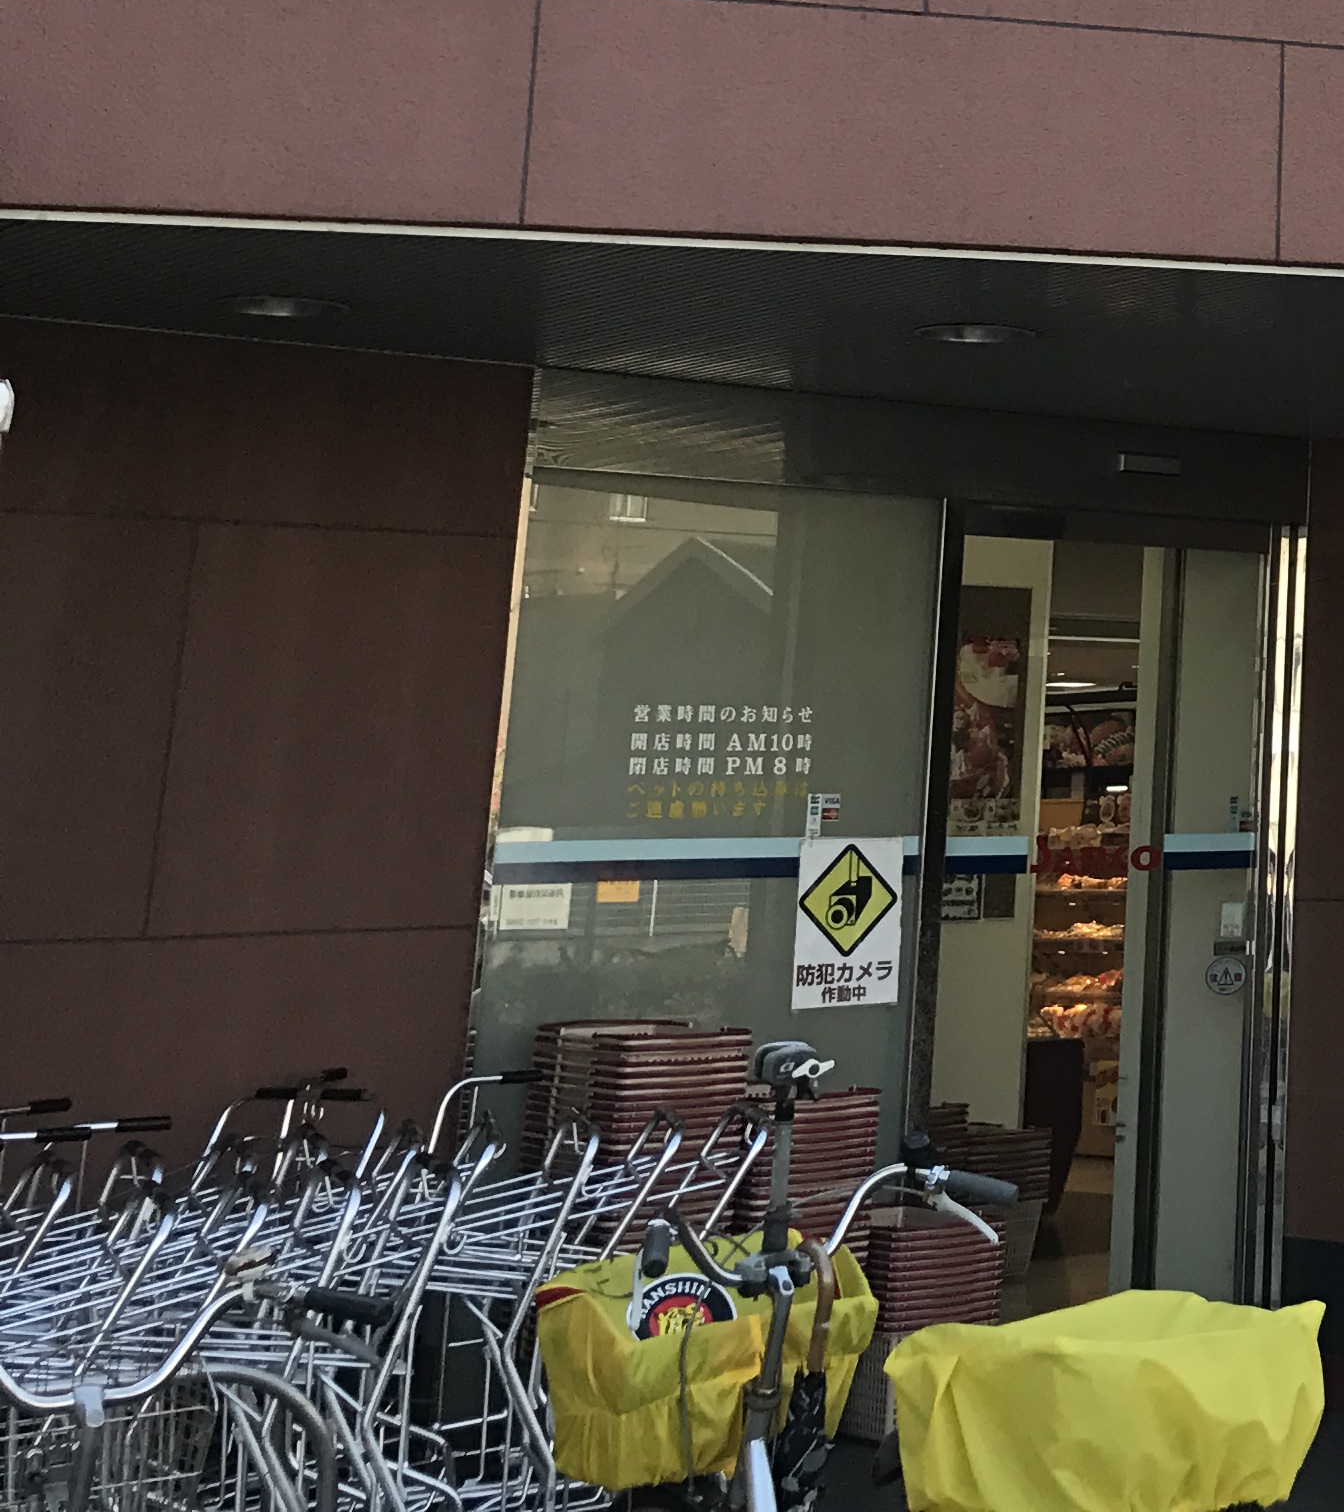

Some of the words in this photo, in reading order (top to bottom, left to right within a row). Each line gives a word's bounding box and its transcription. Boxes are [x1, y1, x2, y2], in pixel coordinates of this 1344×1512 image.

[633, 704, 814, 724] 営業時間のお知らせ
[630, 732, 716, 752] 開店時間
[628, 756, 715, 776] 閉店時間
[796, 961, 893, 987] 防犯カメラ
[821, 985, 867, 1003] 作動中
